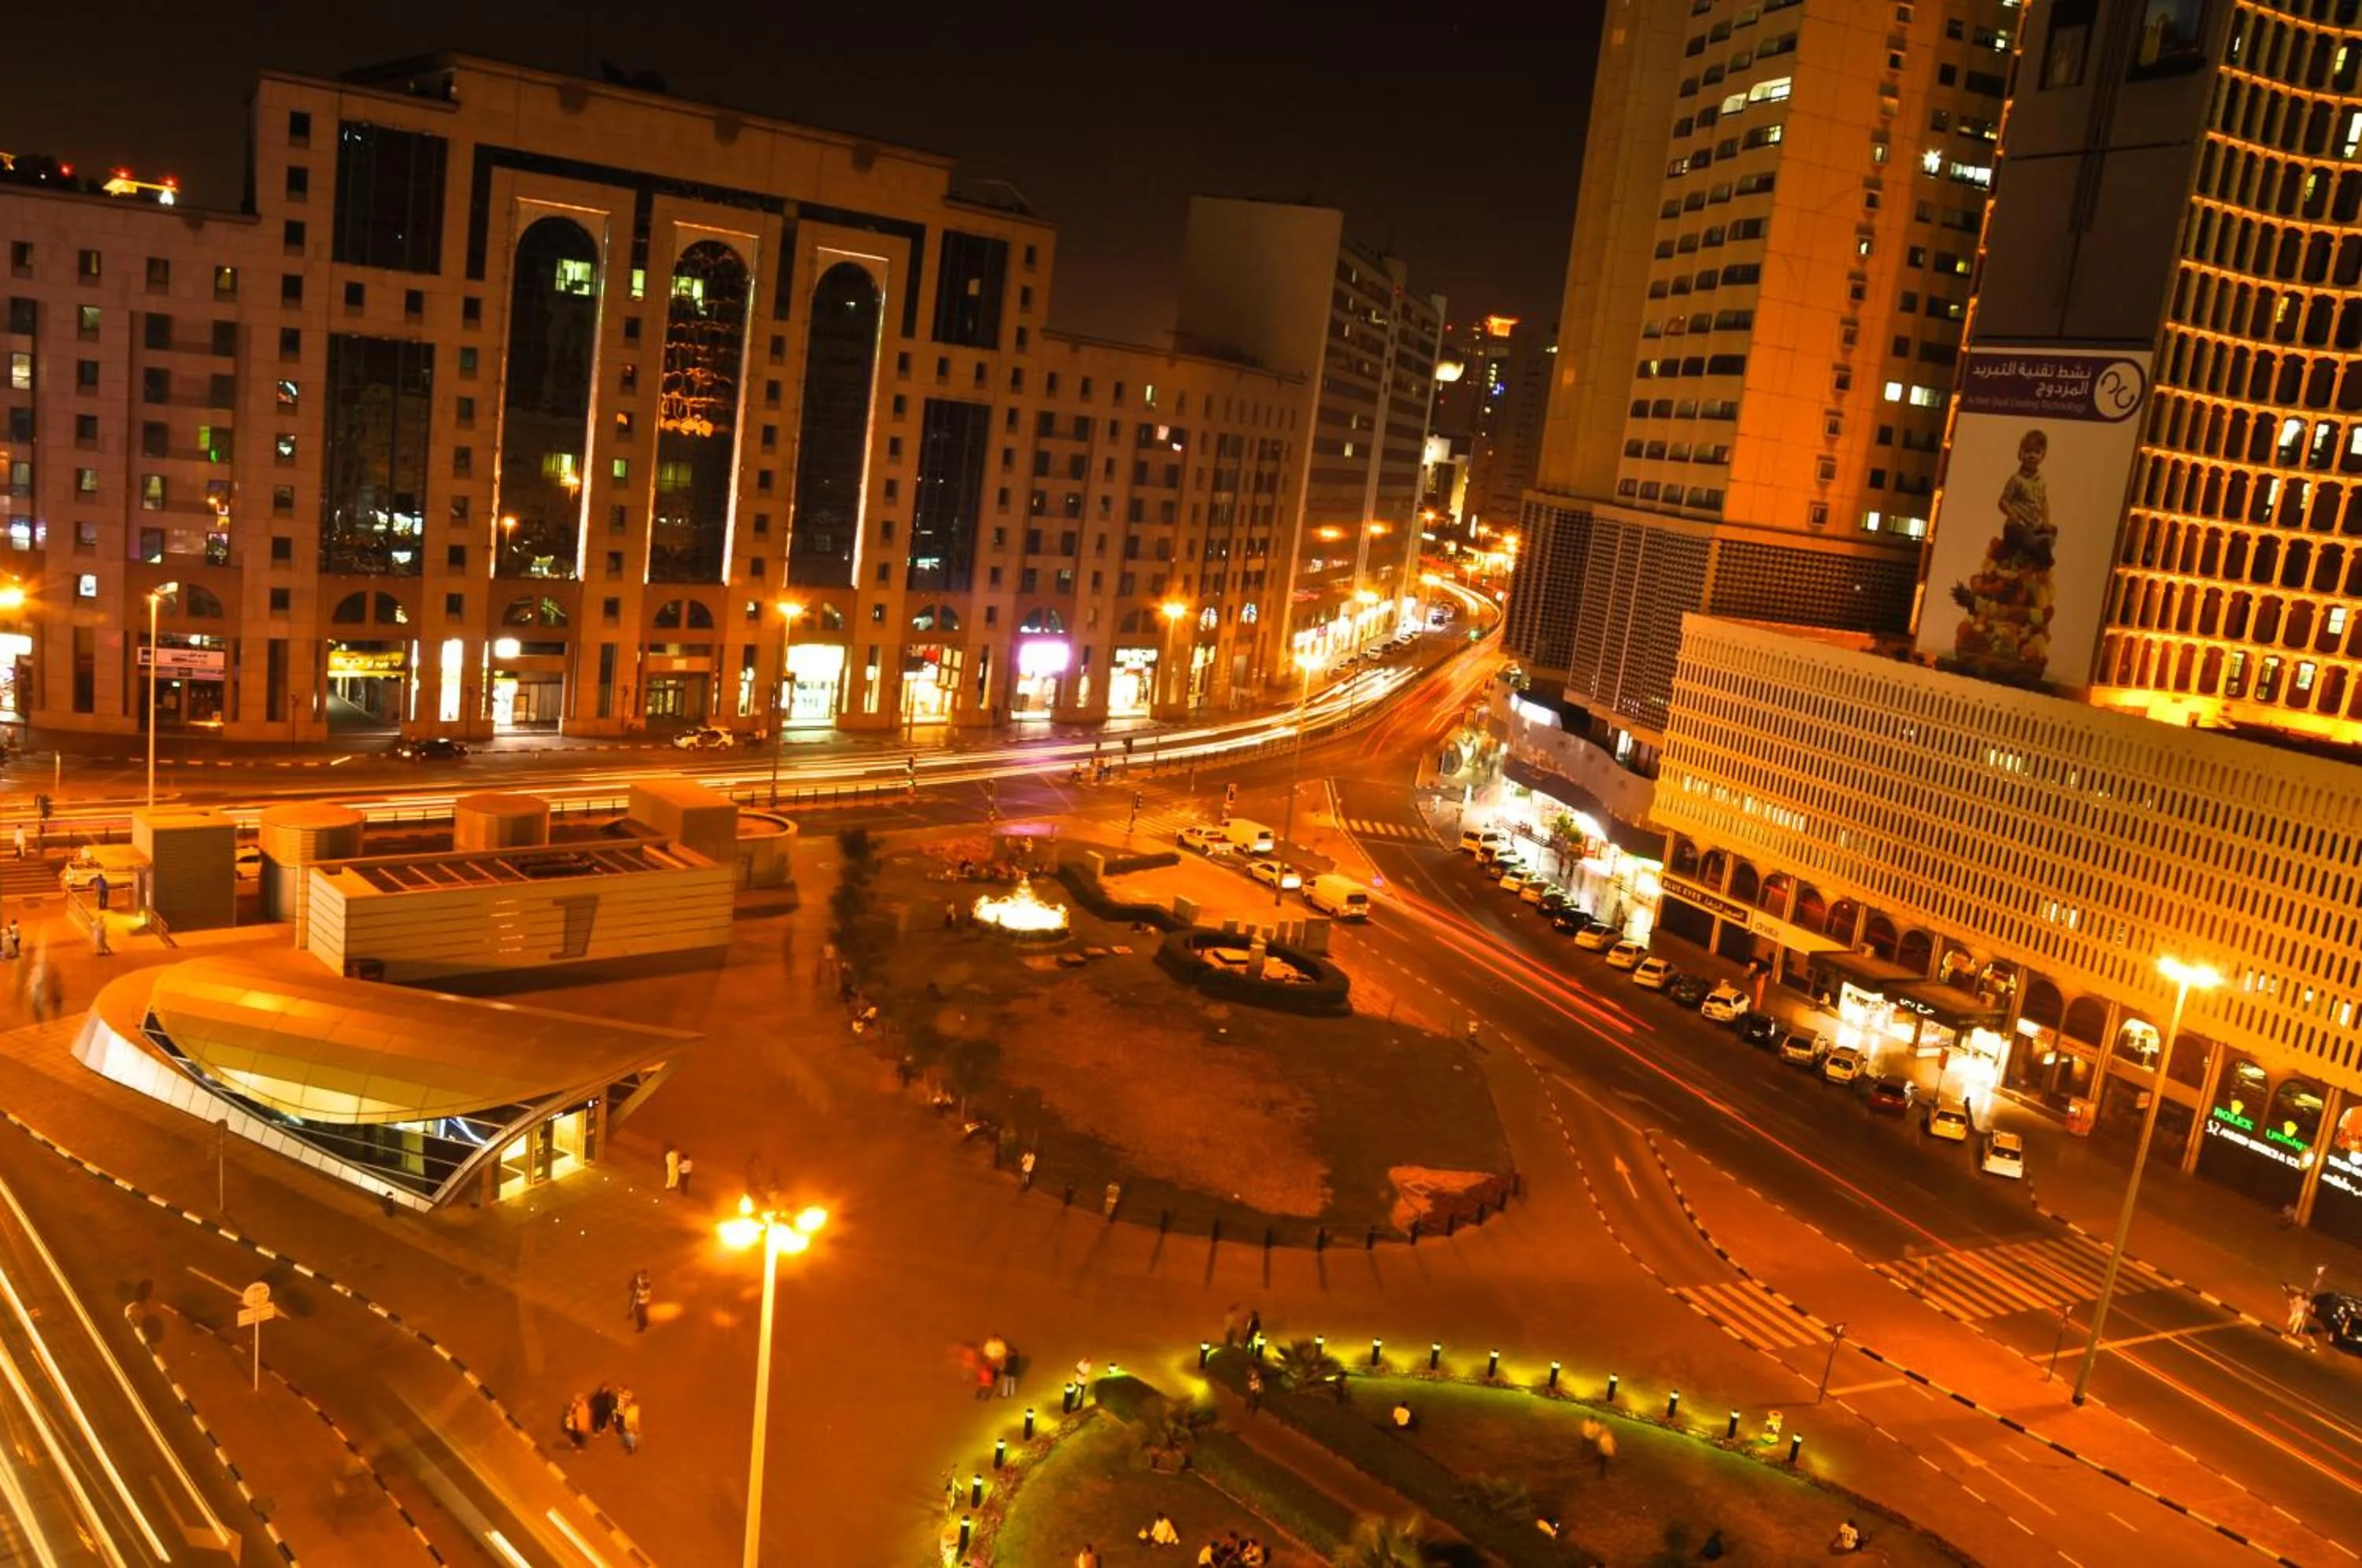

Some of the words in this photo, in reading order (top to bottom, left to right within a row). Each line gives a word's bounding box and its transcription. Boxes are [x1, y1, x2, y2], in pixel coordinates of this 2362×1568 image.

[1971, 360, 2017, 379] التبريد
[2018, 361, 2055, 381] تقنية
[2035, 380, 2090, 398] المزدوج
[2213, 1106, 2254, 1131] ROLEX
